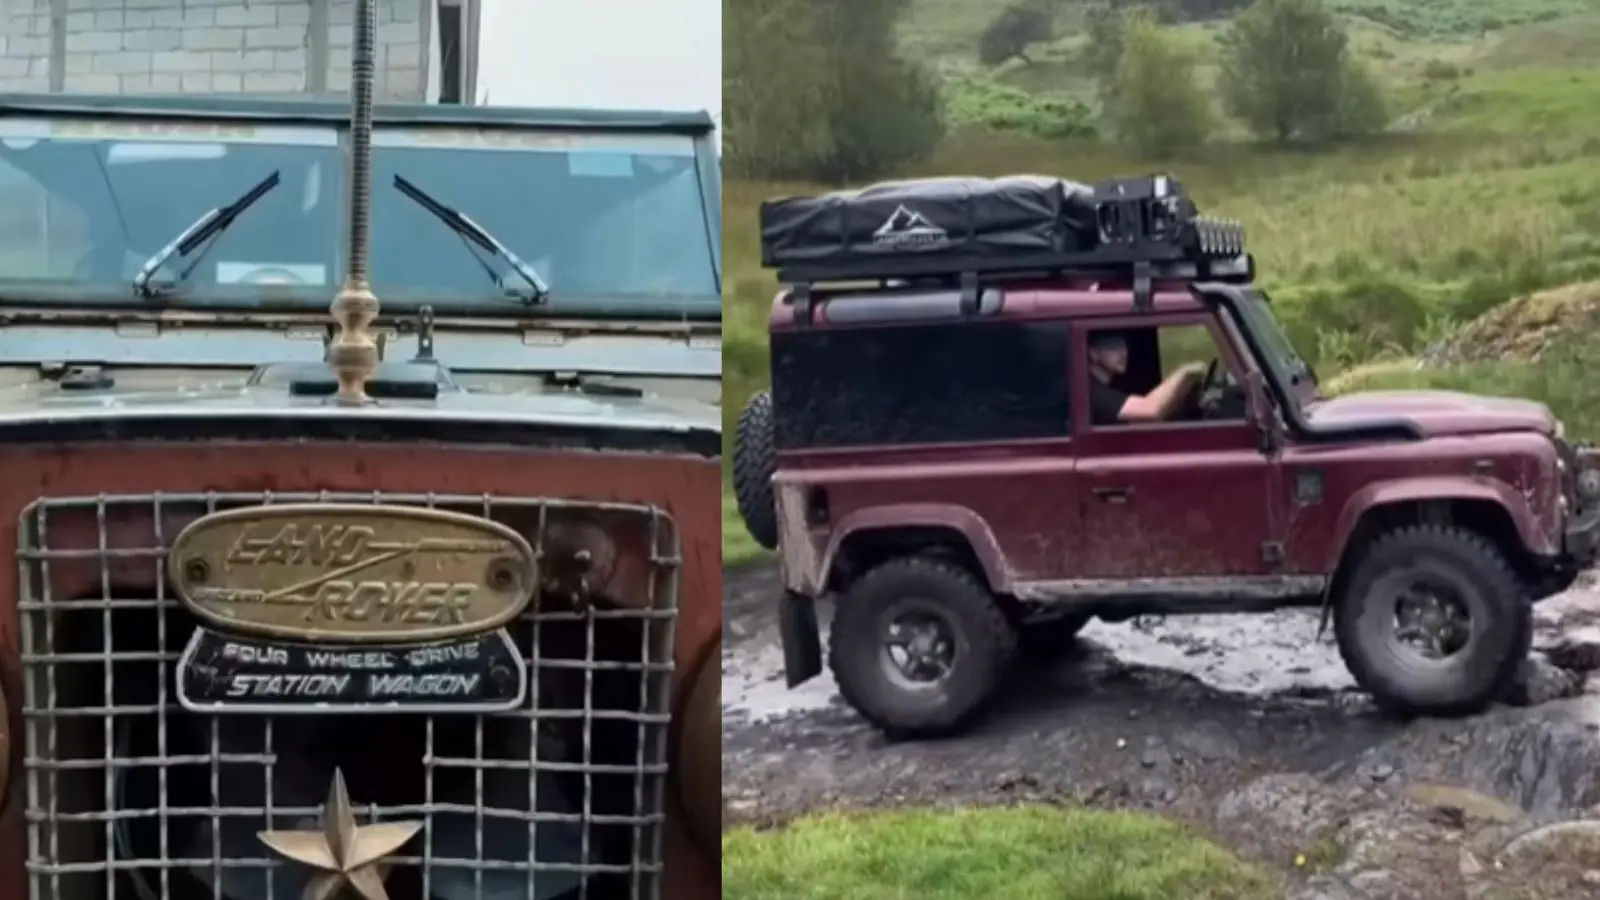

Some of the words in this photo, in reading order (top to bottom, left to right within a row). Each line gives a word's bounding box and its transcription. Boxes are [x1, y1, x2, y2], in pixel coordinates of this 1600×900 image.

[224, 524, 375, 566] LAND
[302, 580, 480, 624] ROVER
[223, 642, 288, 665] FOUR
[306, 645, 395, 669] WHEEL
[408, 641, 480, 666] DRIVE
[226, 674, 350, 696] STATION
[370, 674, 480, 695] WAGON
